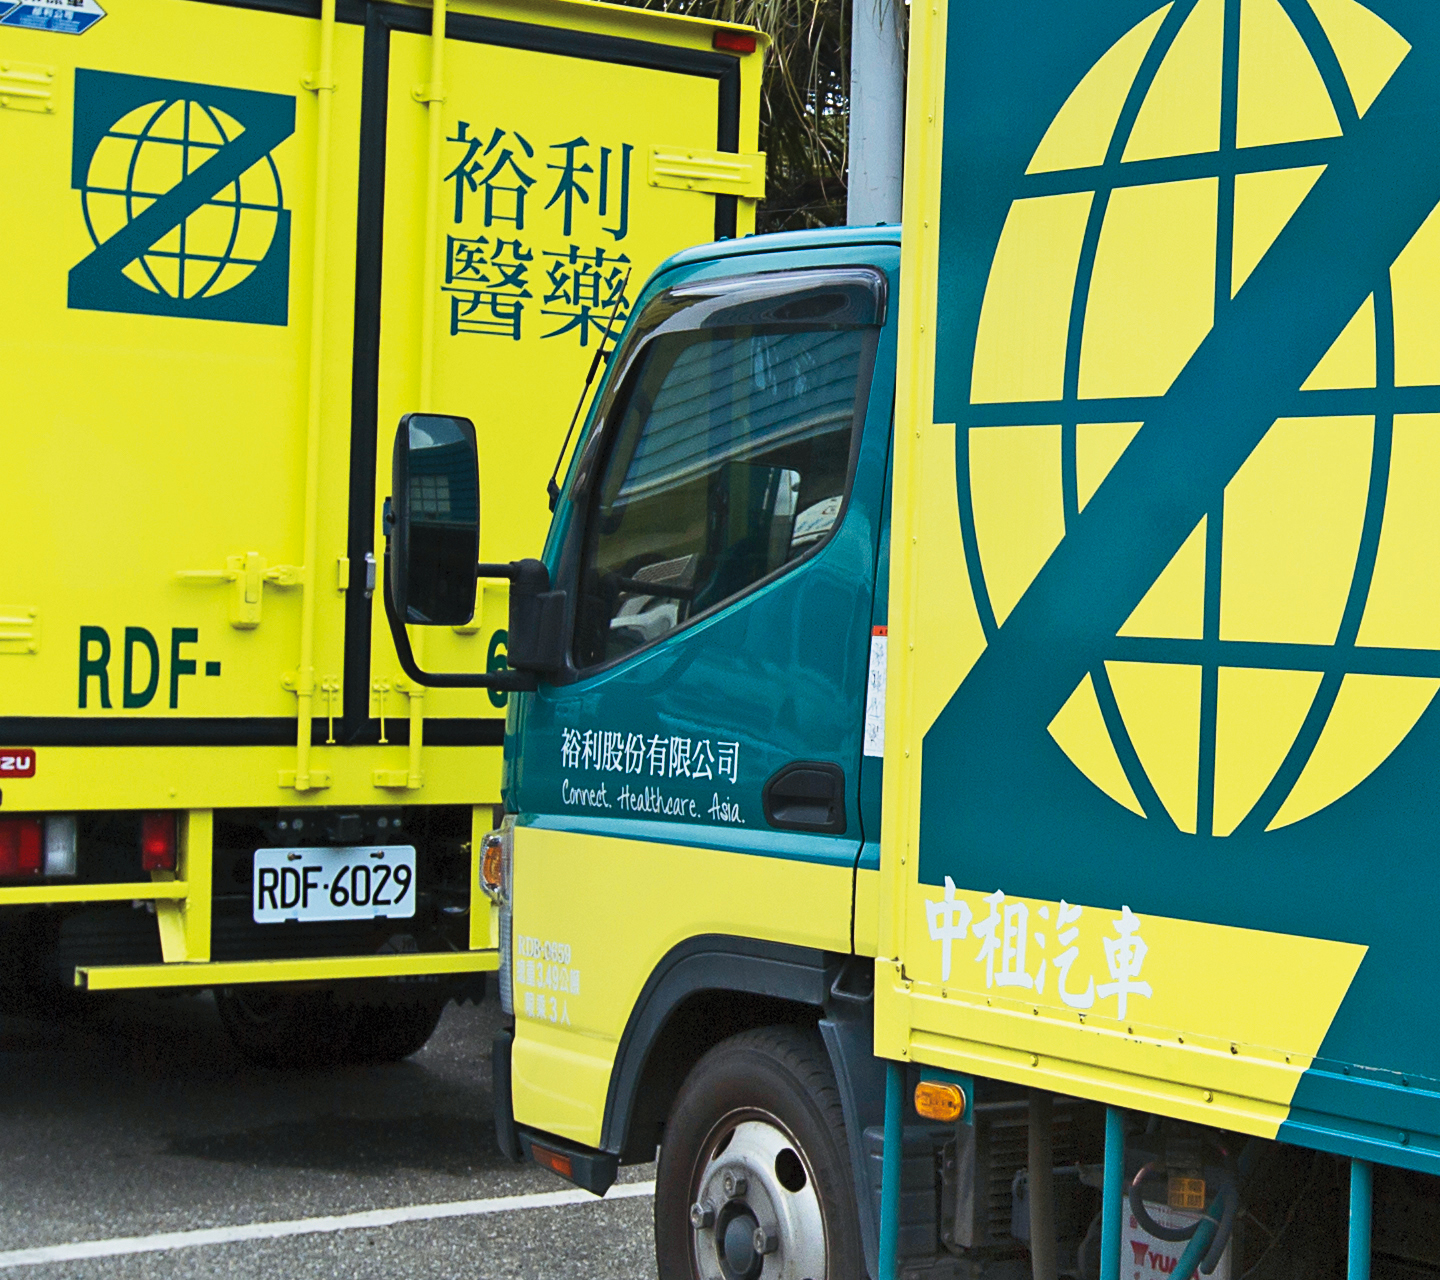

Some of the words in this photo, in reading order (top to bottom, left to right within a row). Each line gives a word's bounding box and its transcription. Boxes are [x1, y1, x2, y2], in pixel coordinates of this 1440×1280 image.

[444, 121, 635, 241] 裕利
[440, 233, 633, 348] 醫藥
[78, 625, 222, 710] RDF-
[561, 727, 740, 785] 裕利股份有限公司
[562, 778, 613, 809] Connect.
[617, 784, 701, 818] Healthcare.
[707, 792, 746, 824] Asia.
[517, 934, 572, 966] RDB-0659
[923, 875, 1153, 1021] 中租汽車
